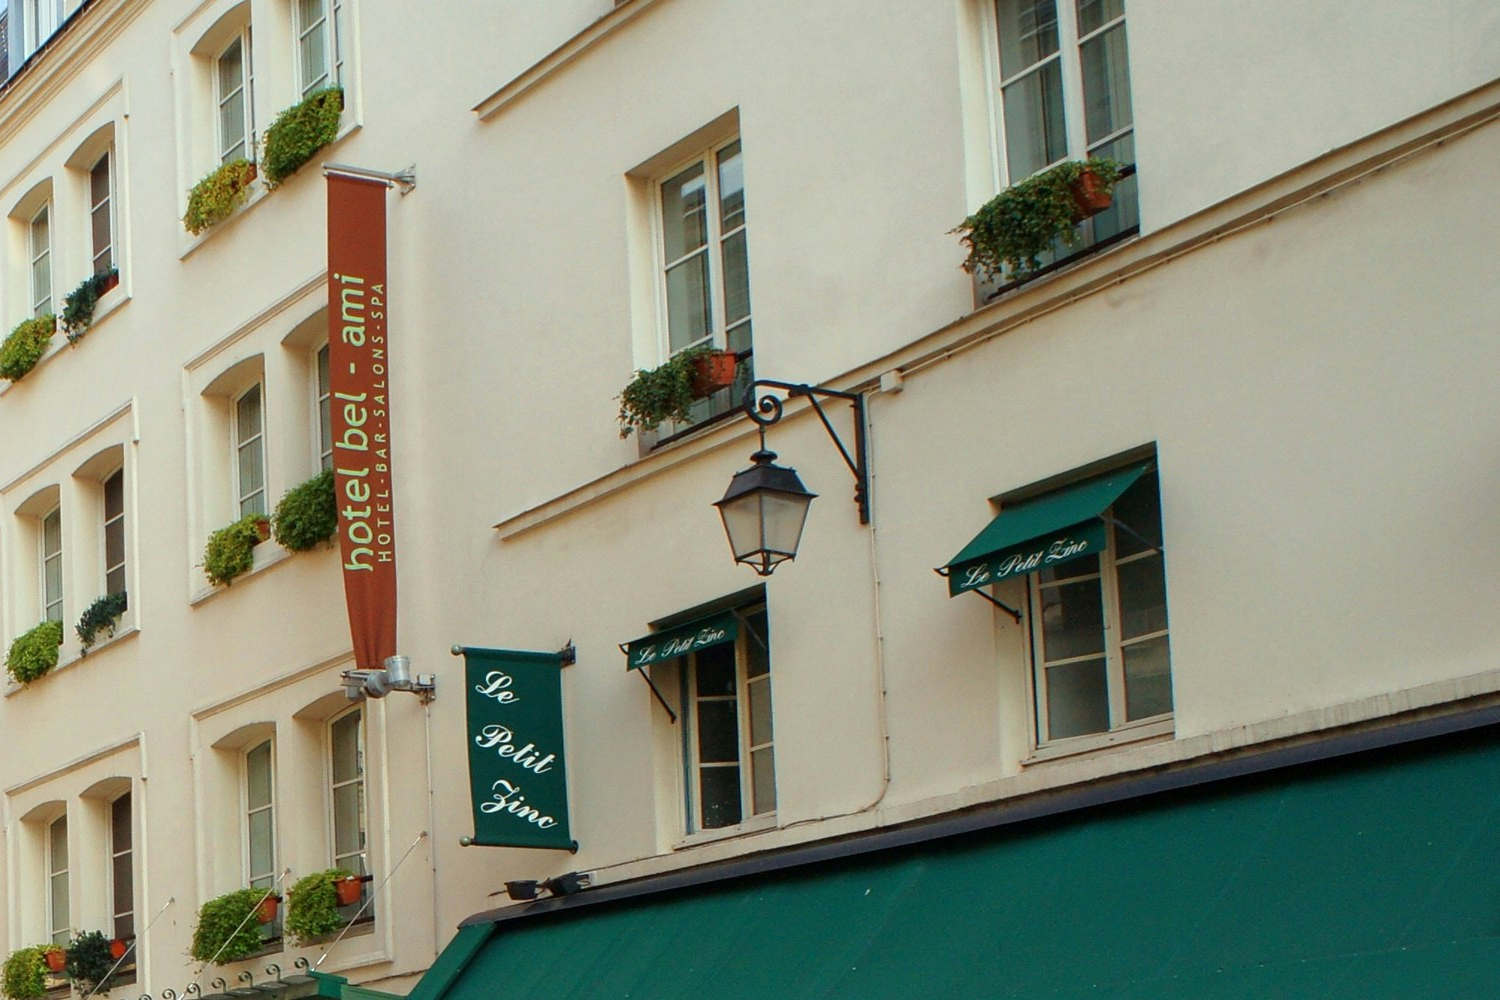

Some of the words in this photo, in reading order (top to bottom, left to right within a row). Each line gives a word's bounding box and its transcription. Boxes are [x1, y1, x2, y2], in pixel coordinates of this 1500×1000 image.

[333, 272, 366, 347] ami
[334, 391, 369, 451] bel
[337, 467, 374, 572] hotel
[960, 563, 991, 588] Le
[997, 550, 1044, 577] Petit
[1045, 538, 1088, 564] Zinc
[634, 645, 657, 665] Le
[661, 636, 695, 658] Petit
[694, 627, 725, 648] Zinc
[475, 670, 520, 705] Le
[475, 724, 556, 775] Petit
[480, 779, 558, 830] Zinc
